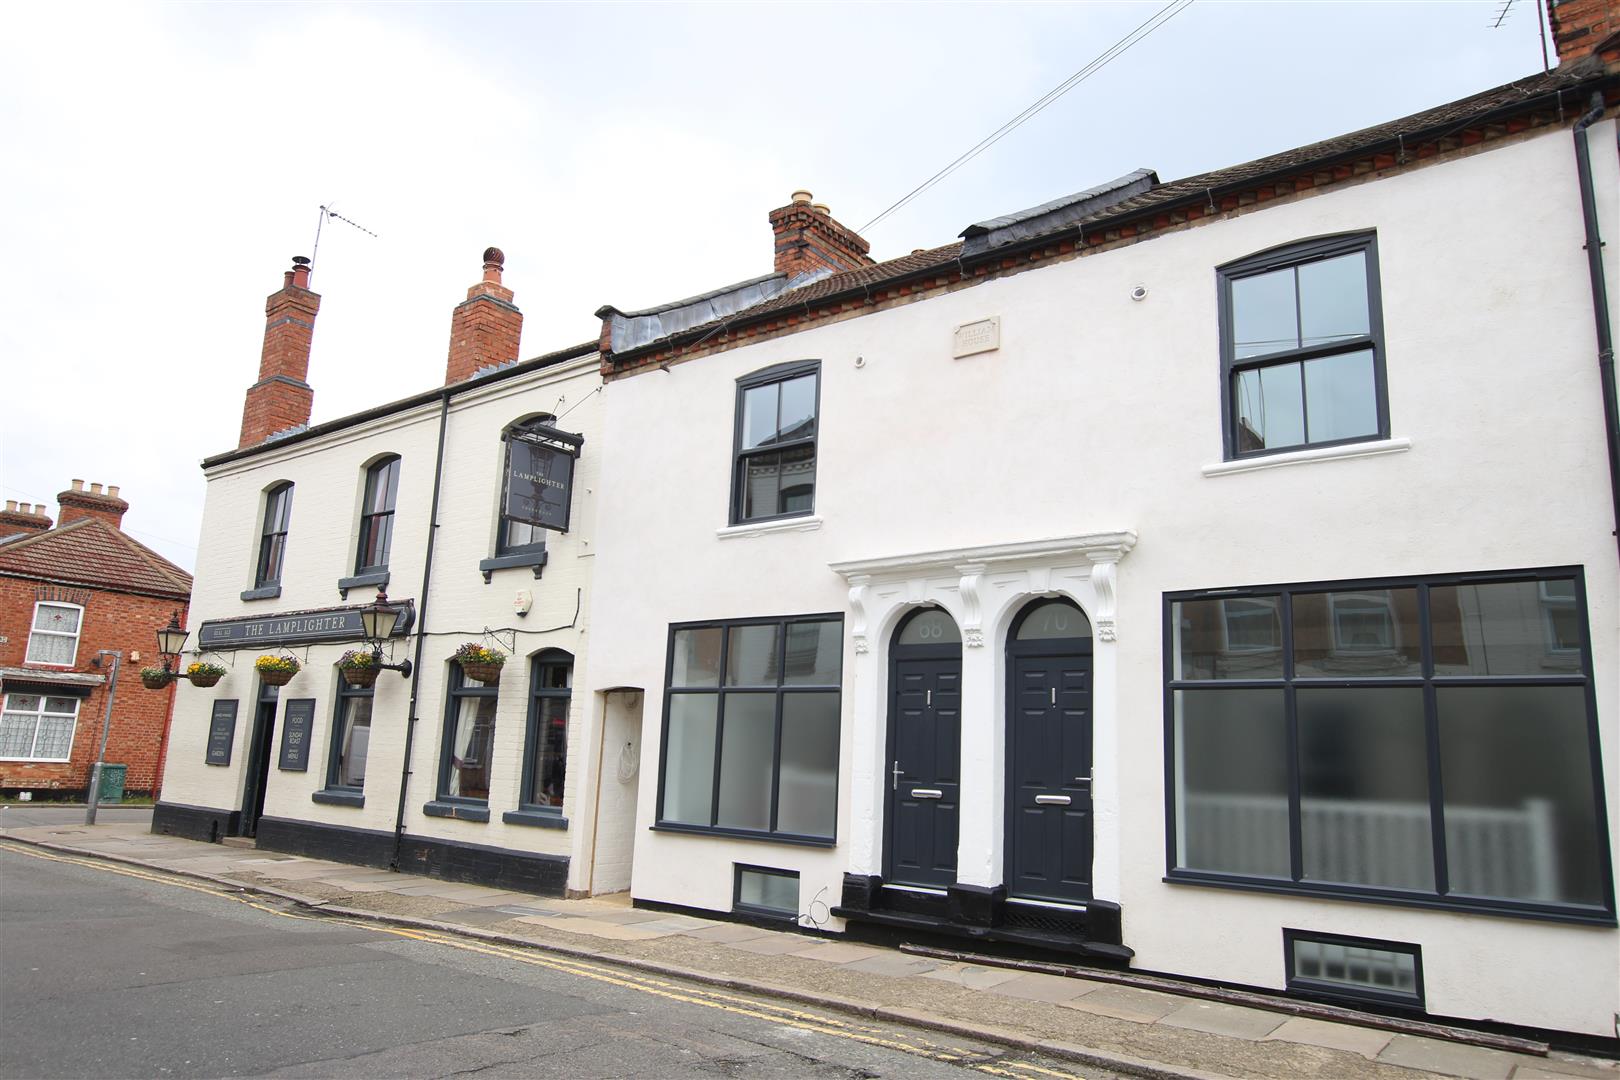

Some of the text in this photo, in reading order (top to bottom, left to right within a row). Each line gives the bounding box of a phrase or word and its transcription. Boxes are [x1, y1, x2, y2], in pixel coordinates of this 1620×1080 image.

[513, 470, 565, 489] LAMPLIGHTER
[244, 624, 264, 637] THE
[268, 616, 346, 635] LAMPLIGHTER
